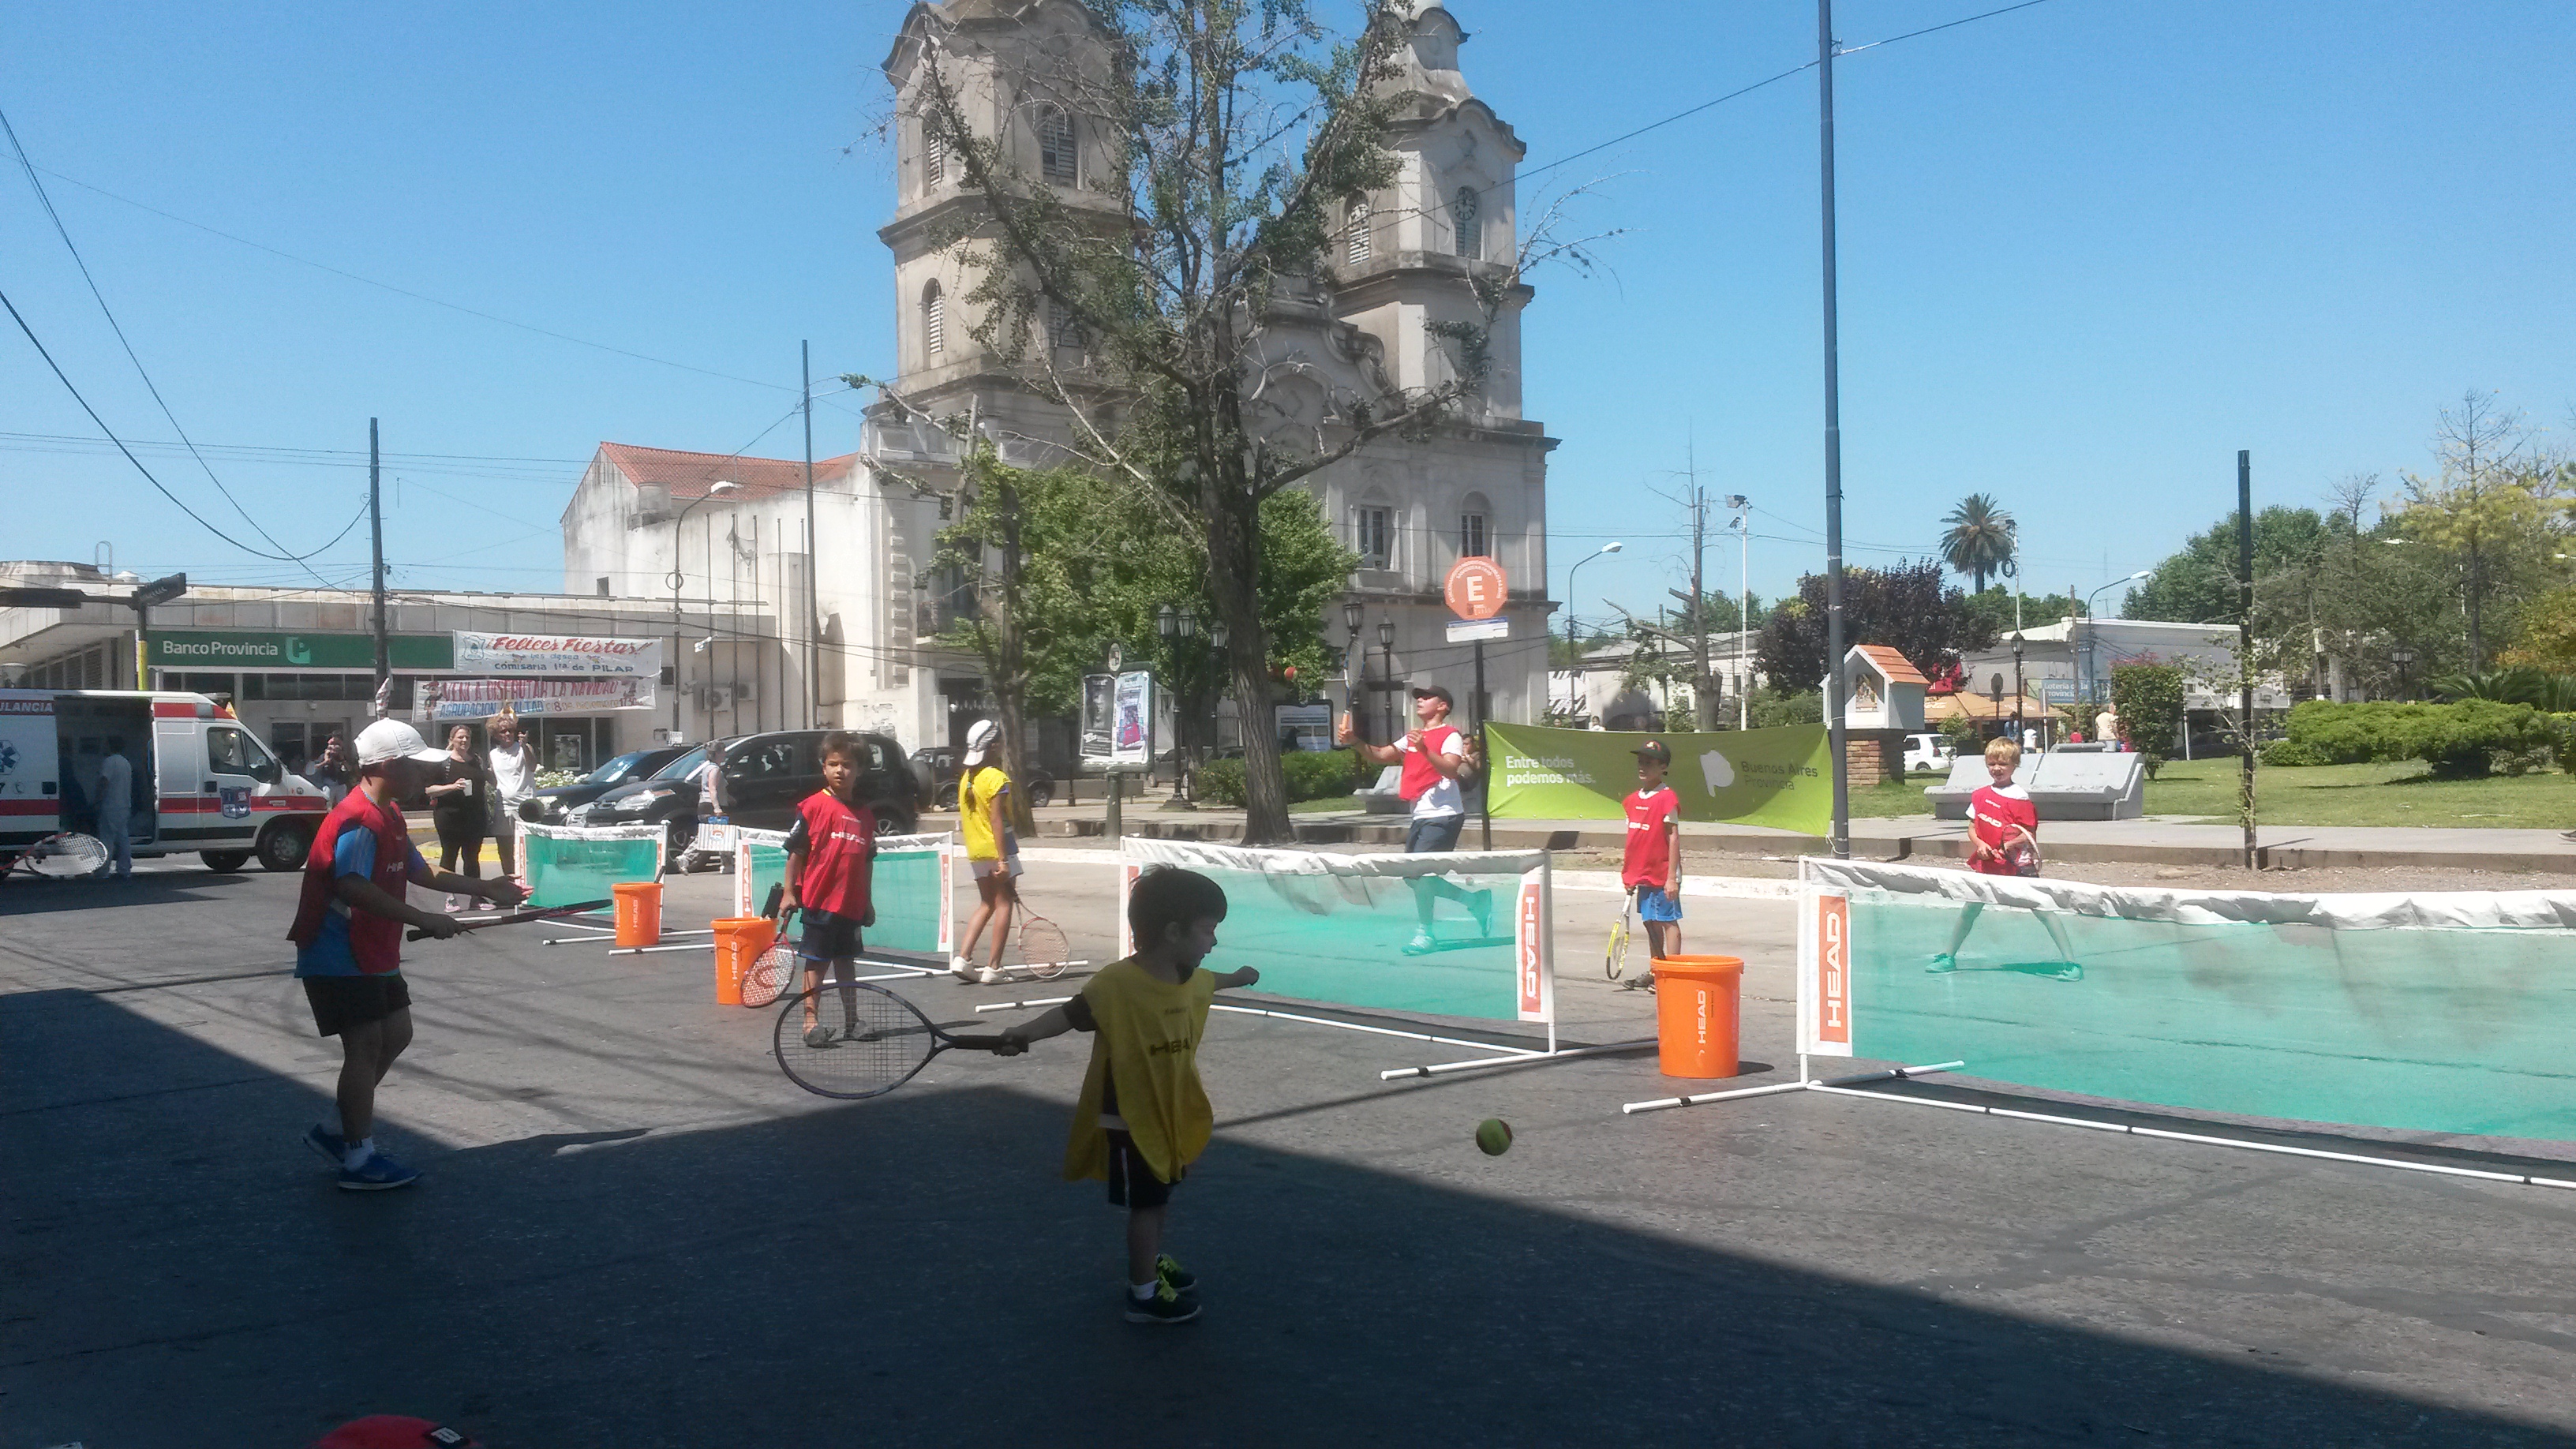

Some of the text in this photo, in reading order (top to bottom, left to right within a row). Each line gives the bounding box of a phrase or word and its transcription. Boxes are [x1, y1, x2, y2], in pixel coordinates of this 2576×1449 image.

[1466, 575, 1485, 602] E
[163, 640, 279, 656] Banco Provincia
[592, 664, 634, 672] PILAR
[486, 680, 548, 700] DISFRUTAR
[552, 681, 567, 698] LA
[1506, 755, 1574, 769] Entre todos
[1741, 761, 1818, 778] Buenos Aires
[1507, 771, 1564, 788] podemos
[1745, 774, 1795, 791] Provincia
[1524, 896, 1537, 999] HEAD
[1826, 912, 1842, 1028] HEAD
[1697, 990, 1706, 1044] HEAD
